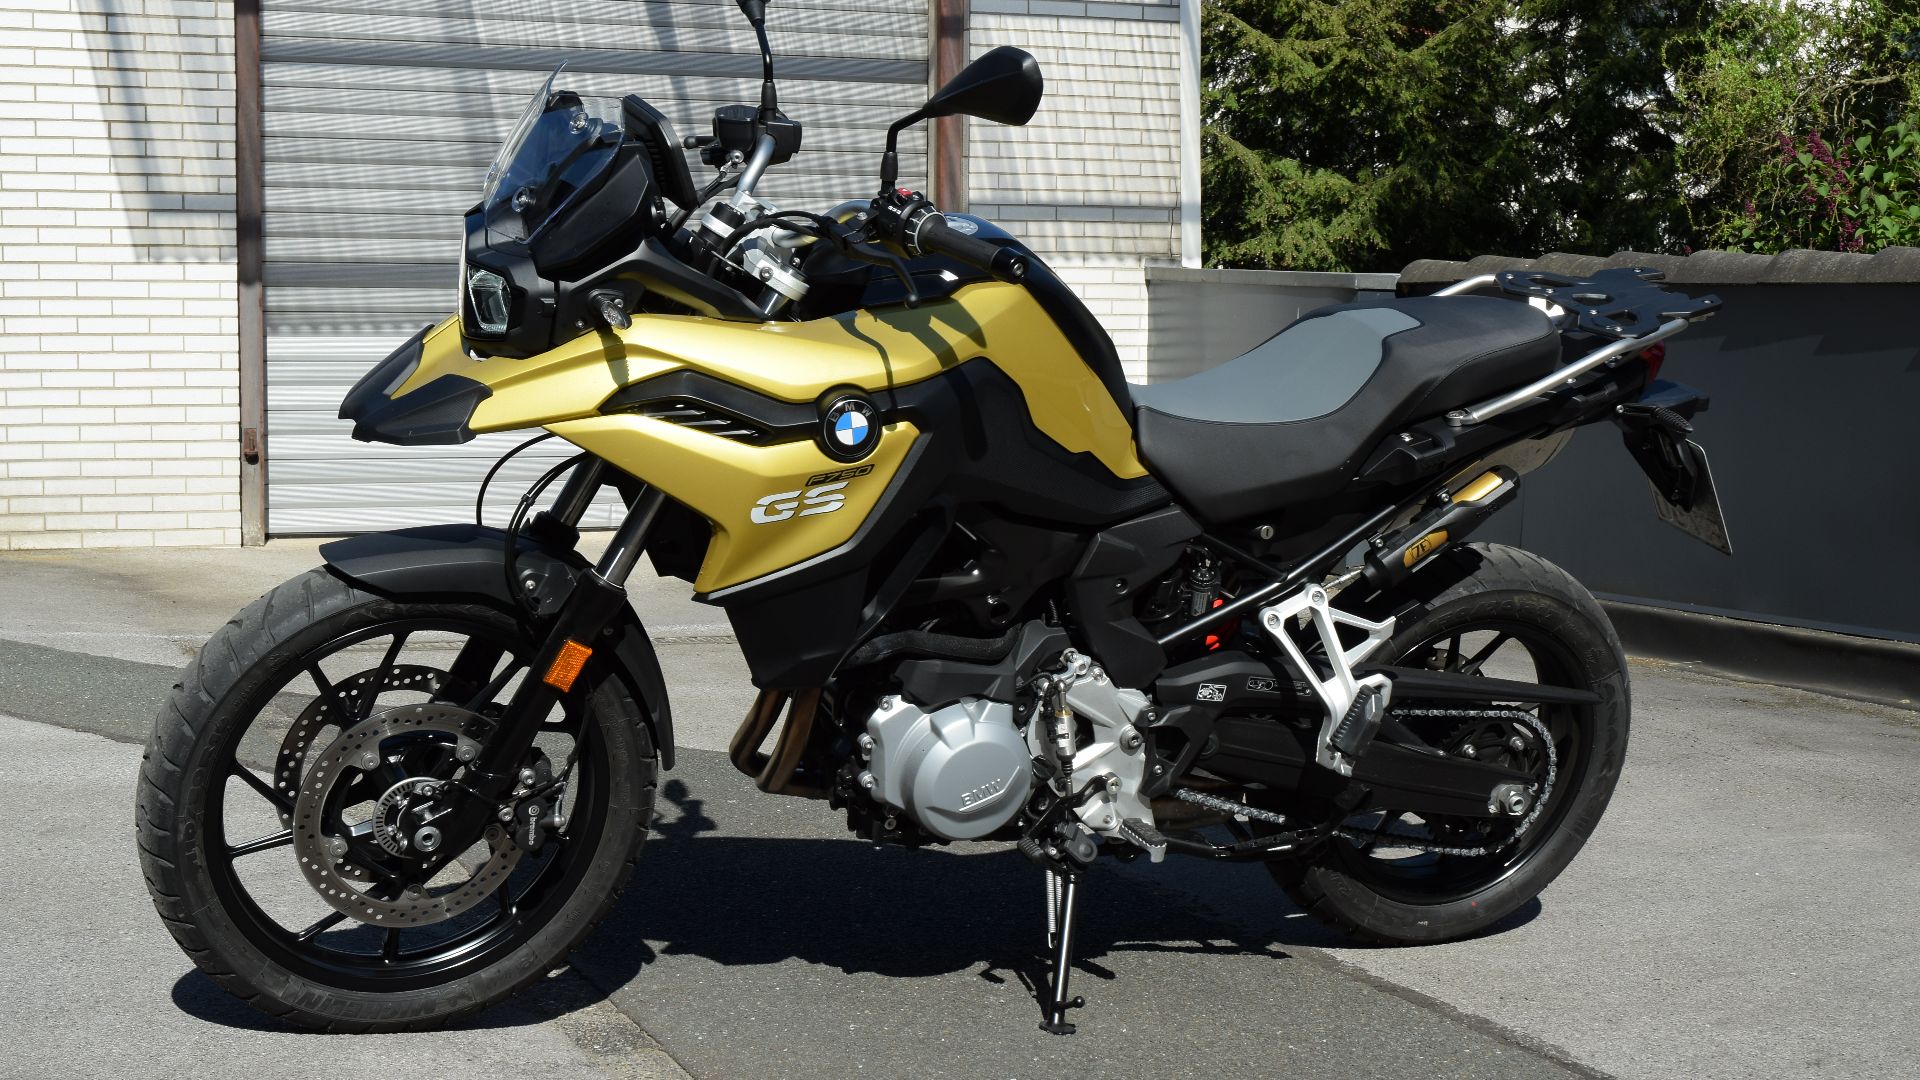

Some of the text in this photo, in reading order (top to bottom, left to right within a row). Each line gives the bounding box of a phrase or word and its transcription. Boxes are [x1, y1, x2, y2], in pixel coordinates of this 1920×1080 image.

[829, 402, 872, 422] BMW
[807, 465, 873, 486] F750
[751, 481, 849, 525] GS
[961, 779, 1001, 807] BMW
[529, 817, 537, 846] brembo
